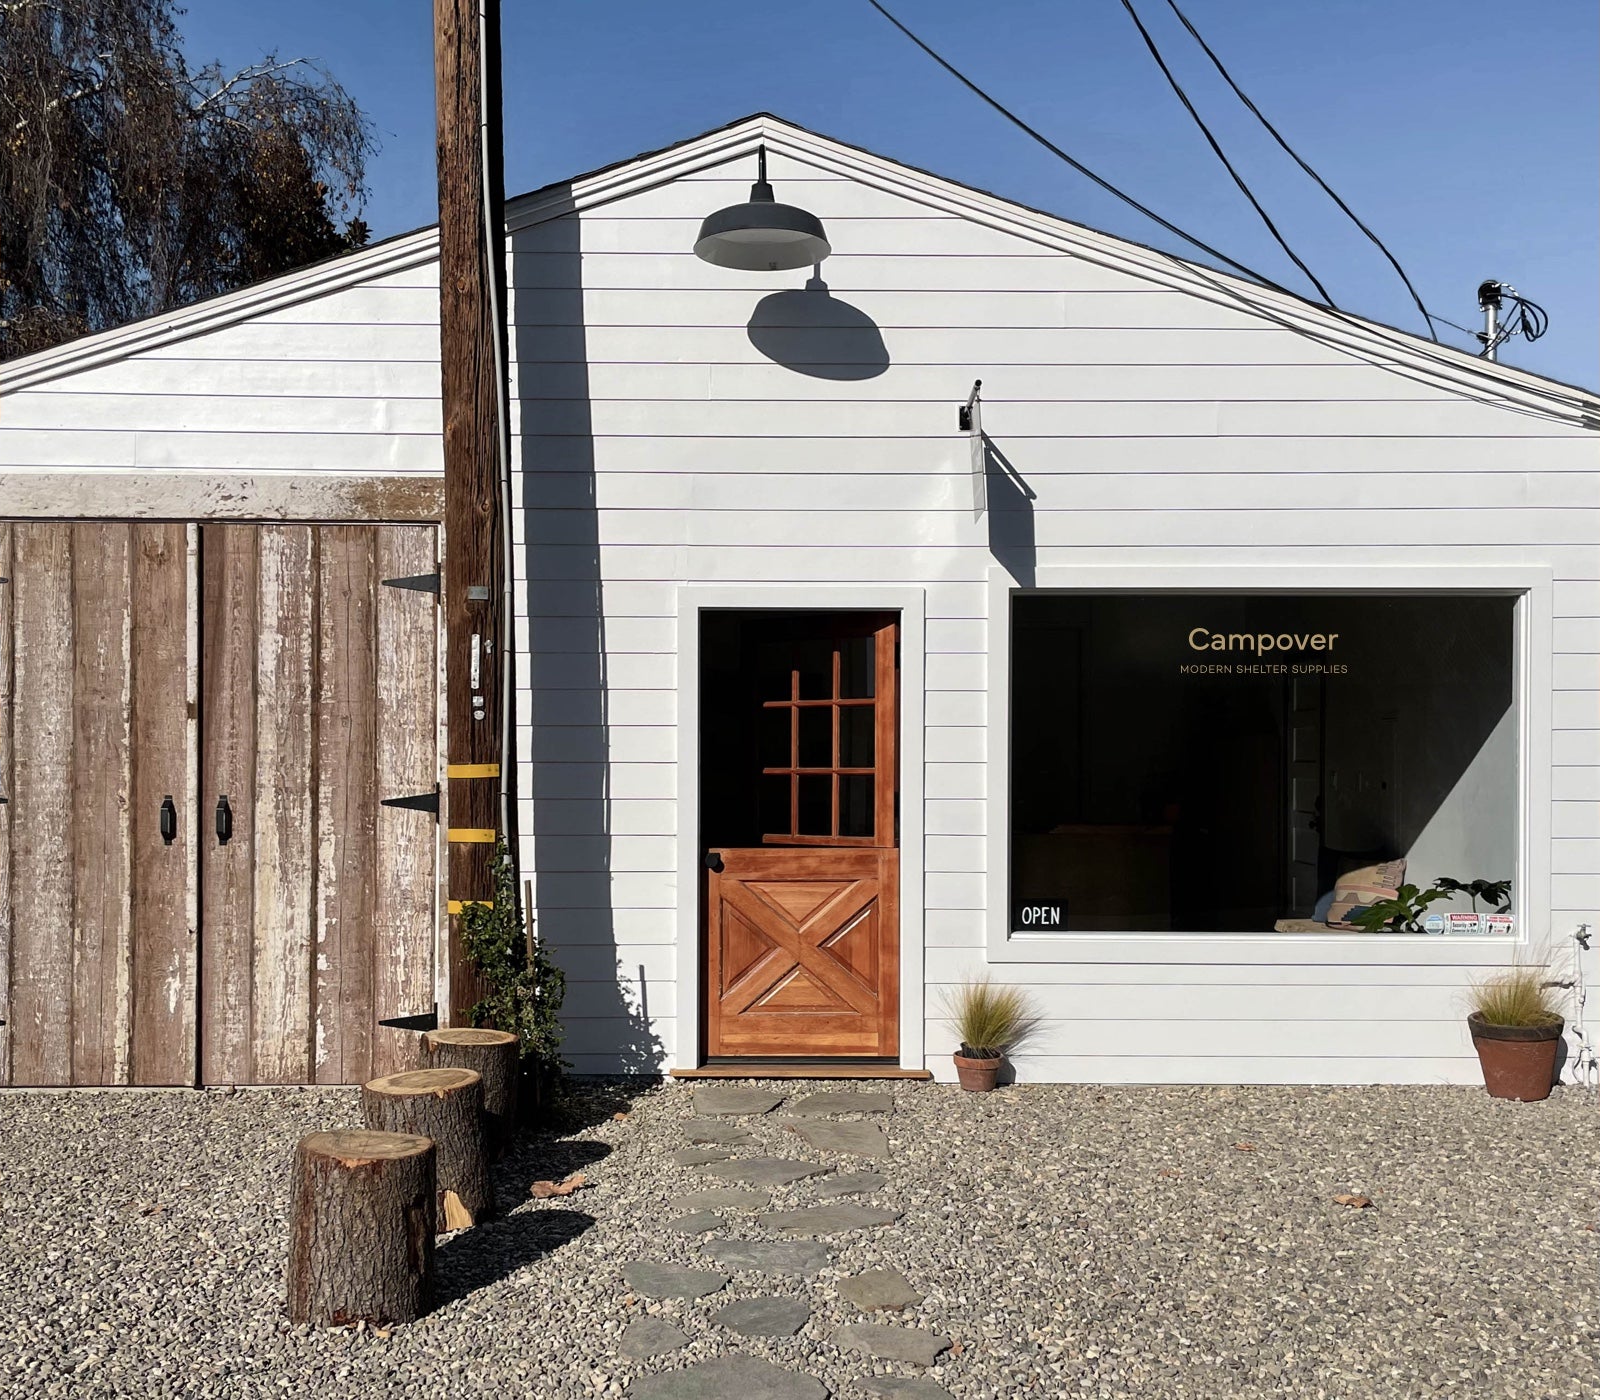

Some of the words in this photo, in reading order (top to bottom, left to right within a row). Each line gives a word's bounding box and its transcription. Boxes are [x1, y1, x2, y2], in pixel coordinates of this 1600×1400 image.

[1188, 627, 1339, 657] Campover
[1180, 664, 1232, 674] MODERN
[1236, 664, 1288, 674] SHELTER
[1291, 664, 1348, 674] SUPPLIES
[1021, 906, 1060, 925] OPEN
